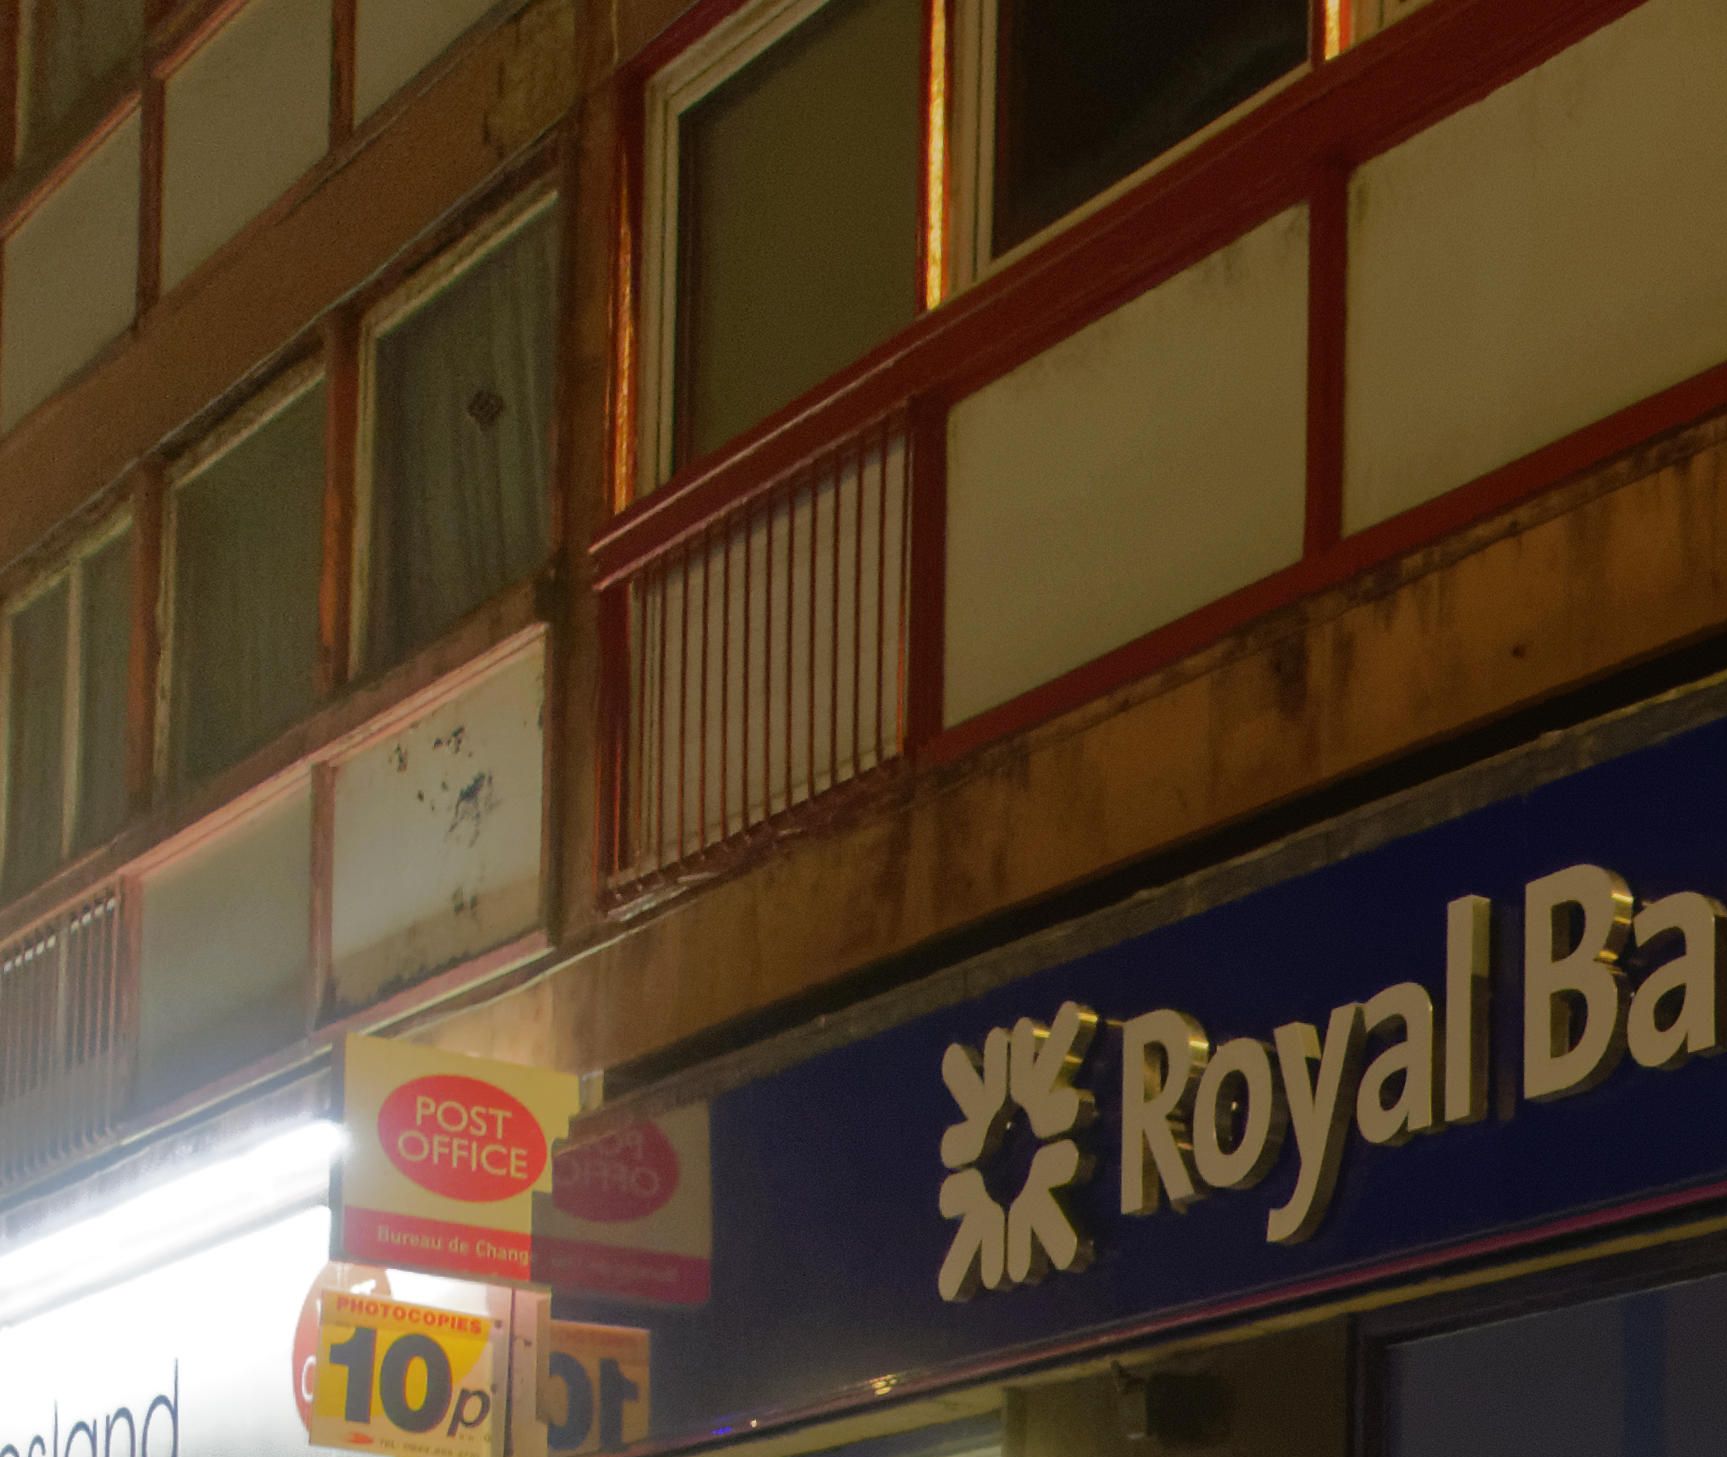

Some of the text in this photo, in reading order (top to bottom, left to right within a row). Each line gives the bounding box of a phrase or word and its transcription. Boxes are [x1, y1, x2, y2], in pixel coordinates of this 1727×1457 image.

[1121, 895, 1491, 1244] Royal
[415, 1095, 513, 1140] POST
[397, 1129, 529, 1180] OFFICE
[376, 1224, 531, 1267] Bureau de Chang
[335, 1295, 483, 1335] PHOTOCOPIES
[329, 1326, 492, 1438] 10p
